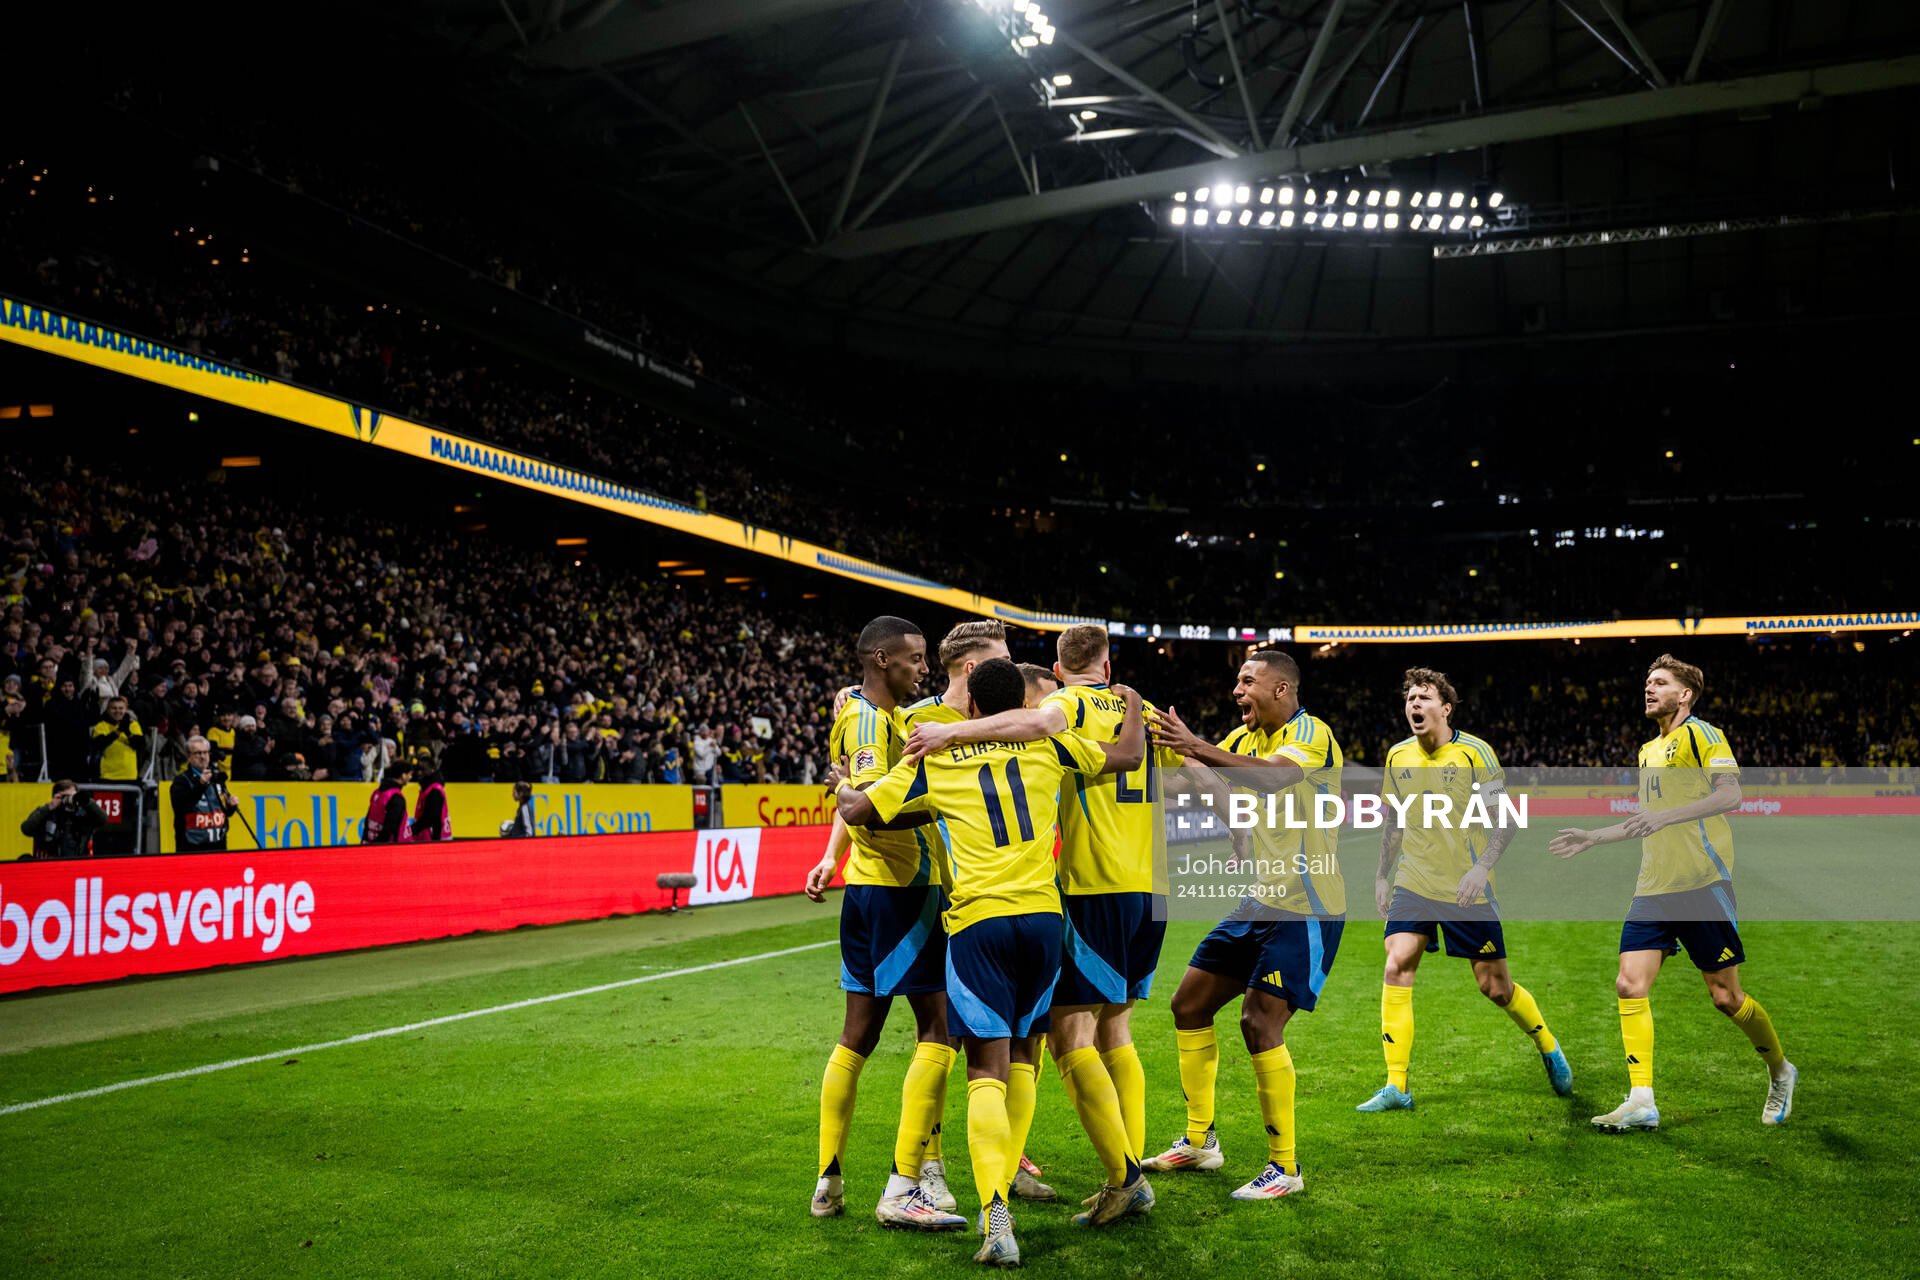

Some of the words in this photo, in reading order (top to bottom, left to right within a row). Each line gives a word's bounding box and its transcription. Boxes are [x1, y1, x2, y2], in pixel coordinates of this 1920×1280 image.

[1153, 624, 1161, 637] 0
[1180, 625, 1210, 639] 02:22
[1228, 627, 1236, 640] 0
[1268, 628, 1292, 640] SVK
[978, 756, 1035, 848] 11
[706, 837, 748, 893] ICA
